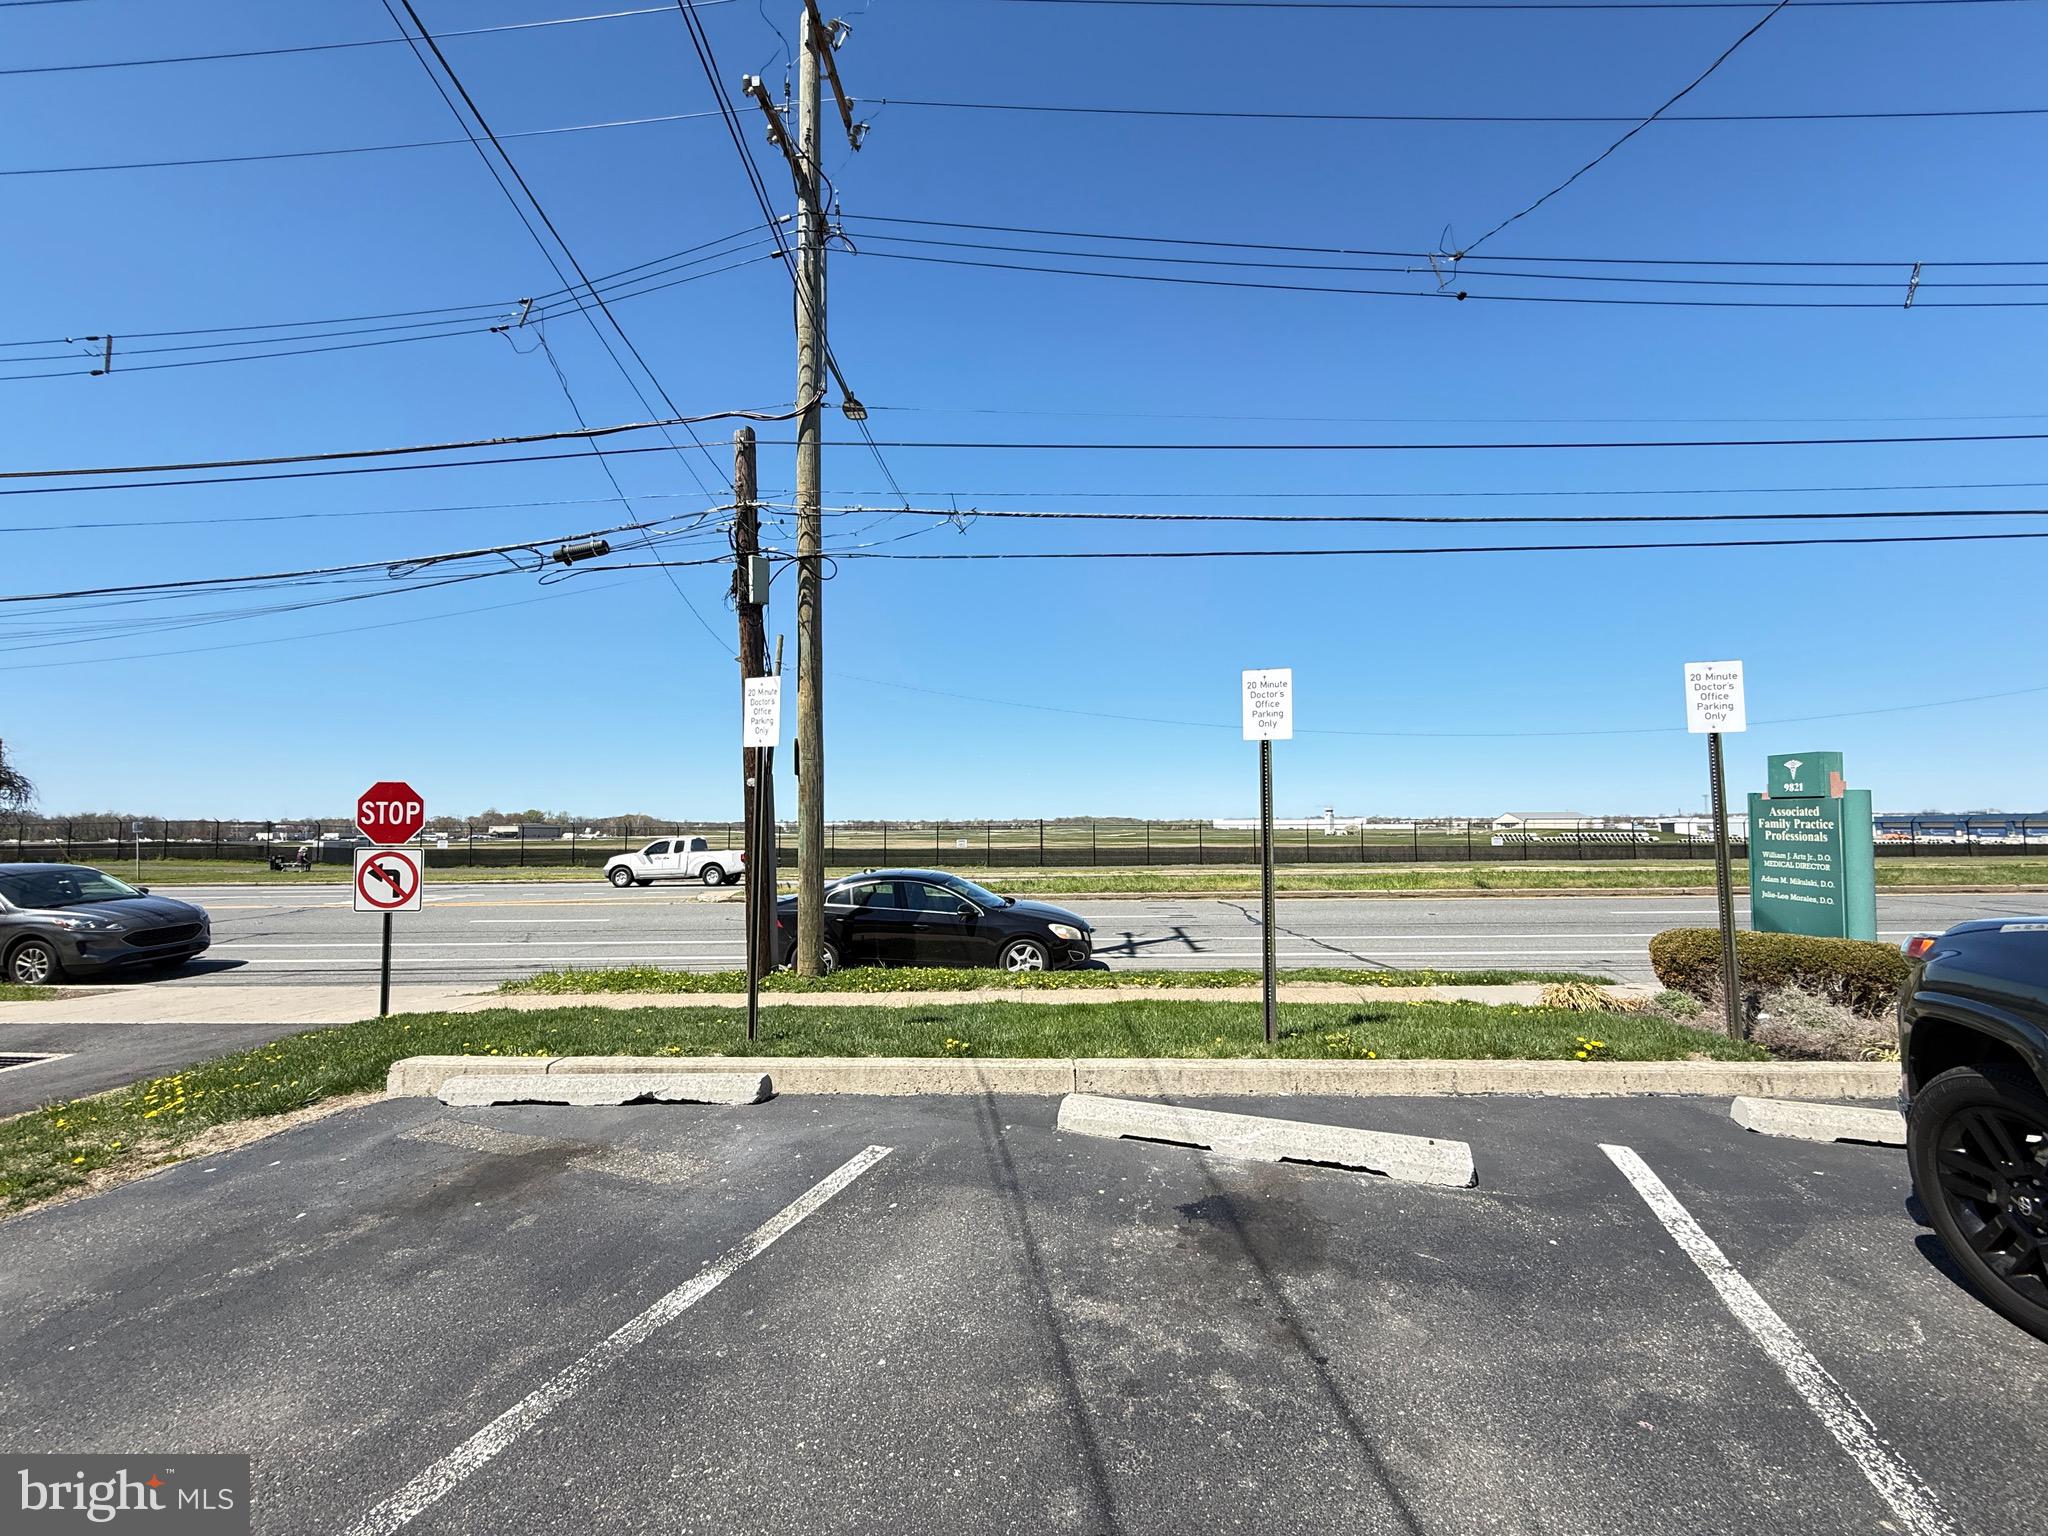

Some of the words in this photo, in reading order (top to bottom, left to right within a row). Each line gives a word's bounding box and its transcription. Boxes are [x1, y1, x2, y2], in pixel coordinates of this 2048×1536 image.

[1690, 673, 1701, 682] 20
[1705, 672, 1738, 681] Minute
[1247, 681, 1257, 690] 20
[1260, 680, 1288, 689] Minute
[1694, 682, 1735, 692] Doctor's
[758, 688, 778, 696] Minute
[1250, 690, 1285, 699] Doctor's
[1700, 692, 1729, 701] Office
[1255, 700, 1280, 709] Office
[1697, 702, 1734, 711] Parking
[753, 707, 772, 716] Office
[1252, 710, 1284, 719] Parking
[1704, 711, 1727, 722] Only
[750, 717, 774, 726] Parking
[1258, 719, 1278, 729] Only
[754, 726, 769, 736] Only
[1783, 782, 1804, 792] 9821
[360, 800, 421, 826] STOP
[1769, 805, 1820, 817] Associated
[1758, 818, 1791, 832] Family
[1794, 818, 1835, 830] Practice
[1764, 830, 1829, 843] Professionals
[1761, 851, 1787, 859] William
[1817, 854, 1832, 862] D.O.
[1763, 860, 1795, 869] MEDICAL
[1795, 861, 1831, 872] DIRECTOR
[1760, 875, 1780, 884] Adam
[1820, 880, 1836, 889] D.O.
[1819, 897, 1835, 906] D.O.
